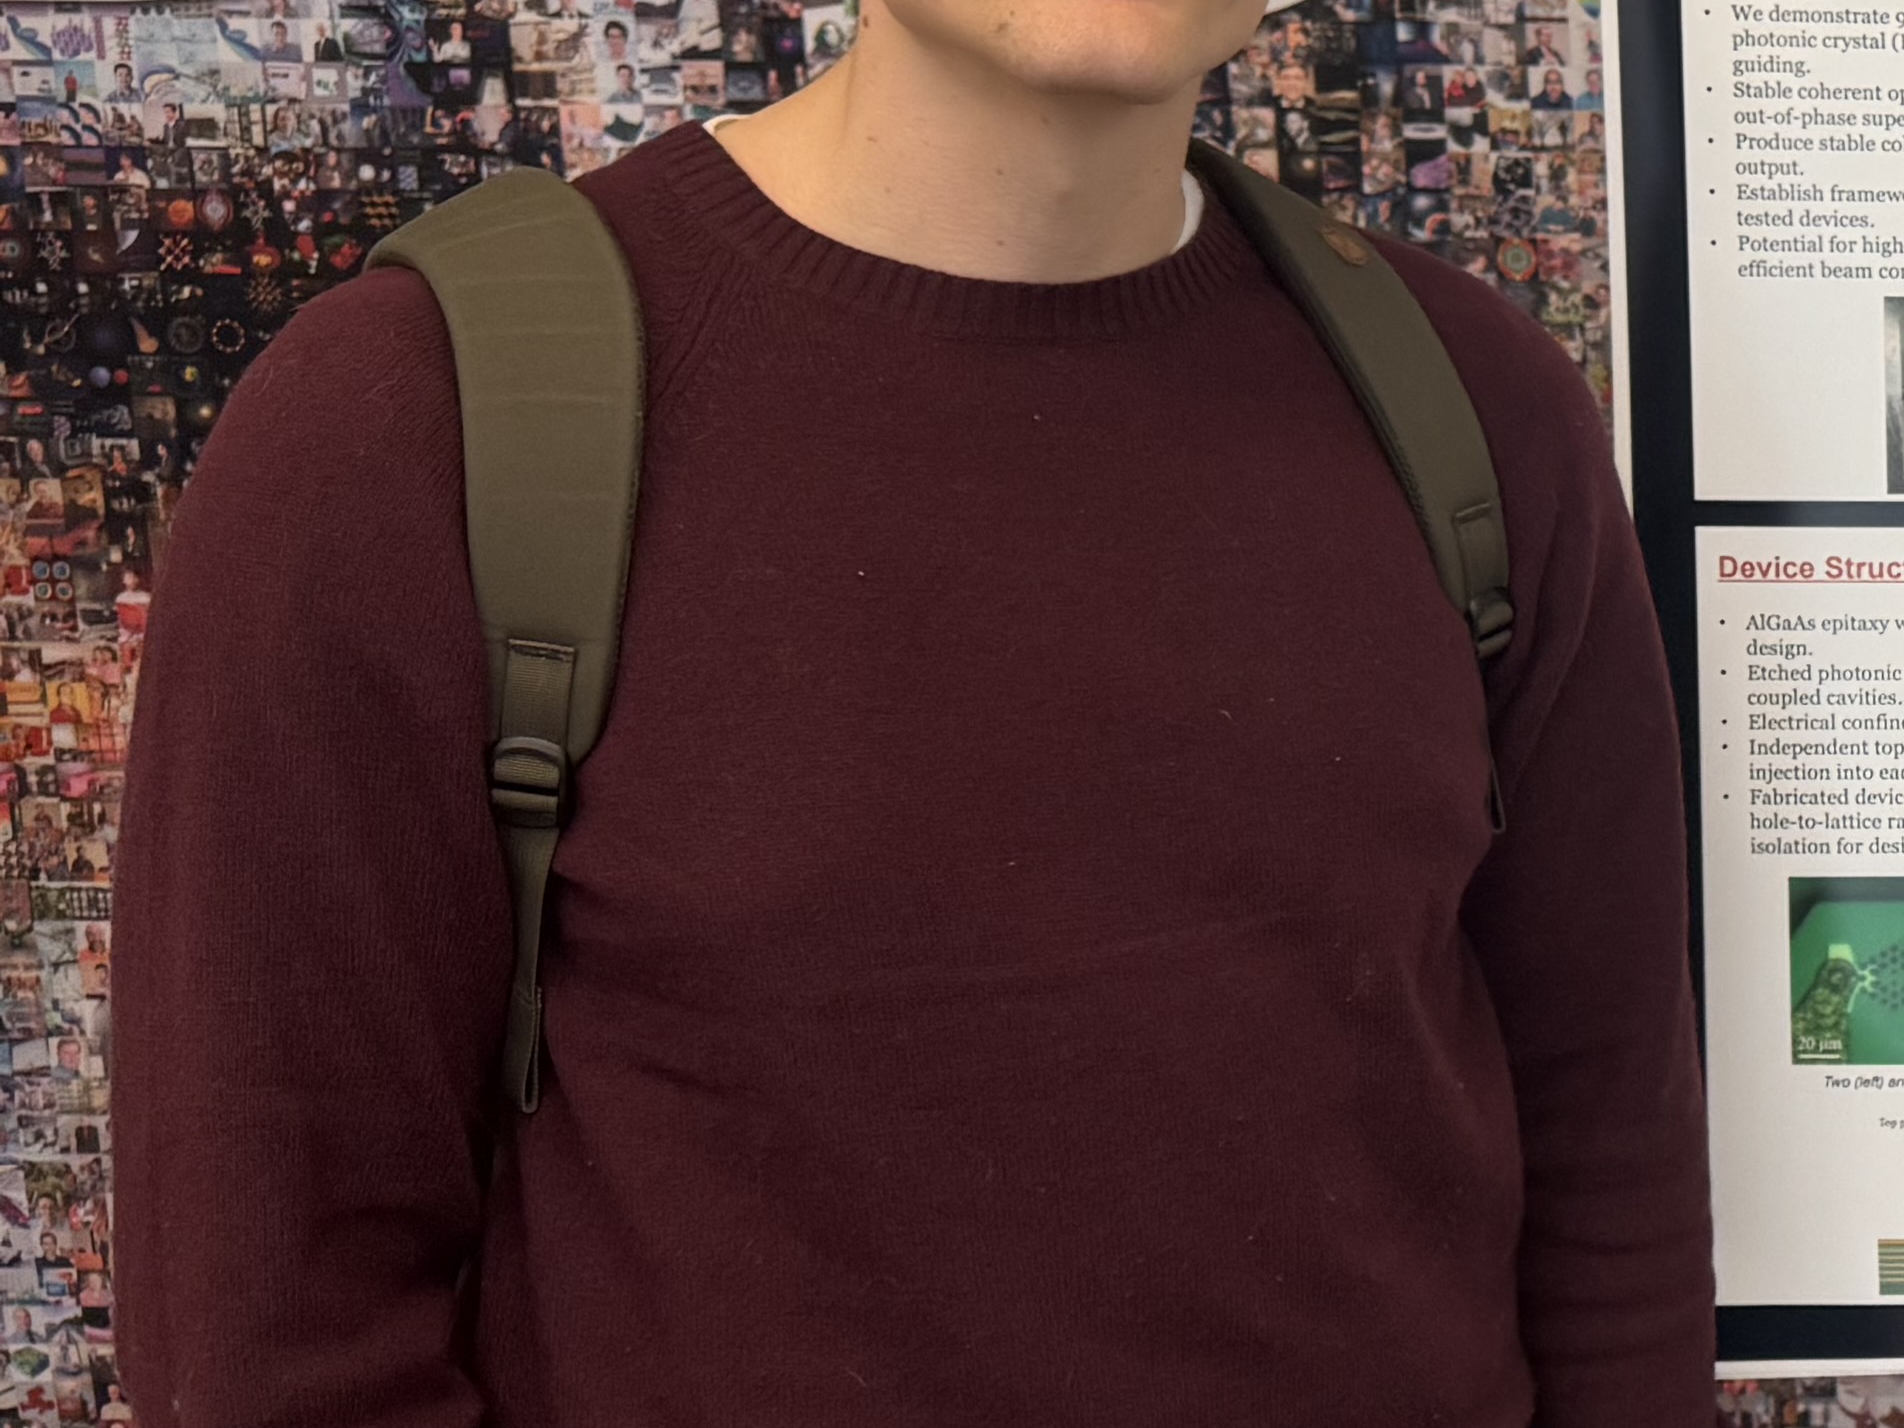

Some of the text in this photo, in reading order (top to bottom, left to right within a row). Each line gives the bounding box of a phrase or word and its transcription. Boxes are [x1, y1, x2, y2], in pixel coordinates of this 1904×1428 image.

[1731, 3, 1764, 24] We
[1768, 4, 1891, 25] demonstrate
[1718, 555, 1815, 582] Device
[1748, 712, 1836, 732] Electrical
[1824, 1074, 1852, 1090] Two
[1853, 1074, 1885, 1092] (left)
